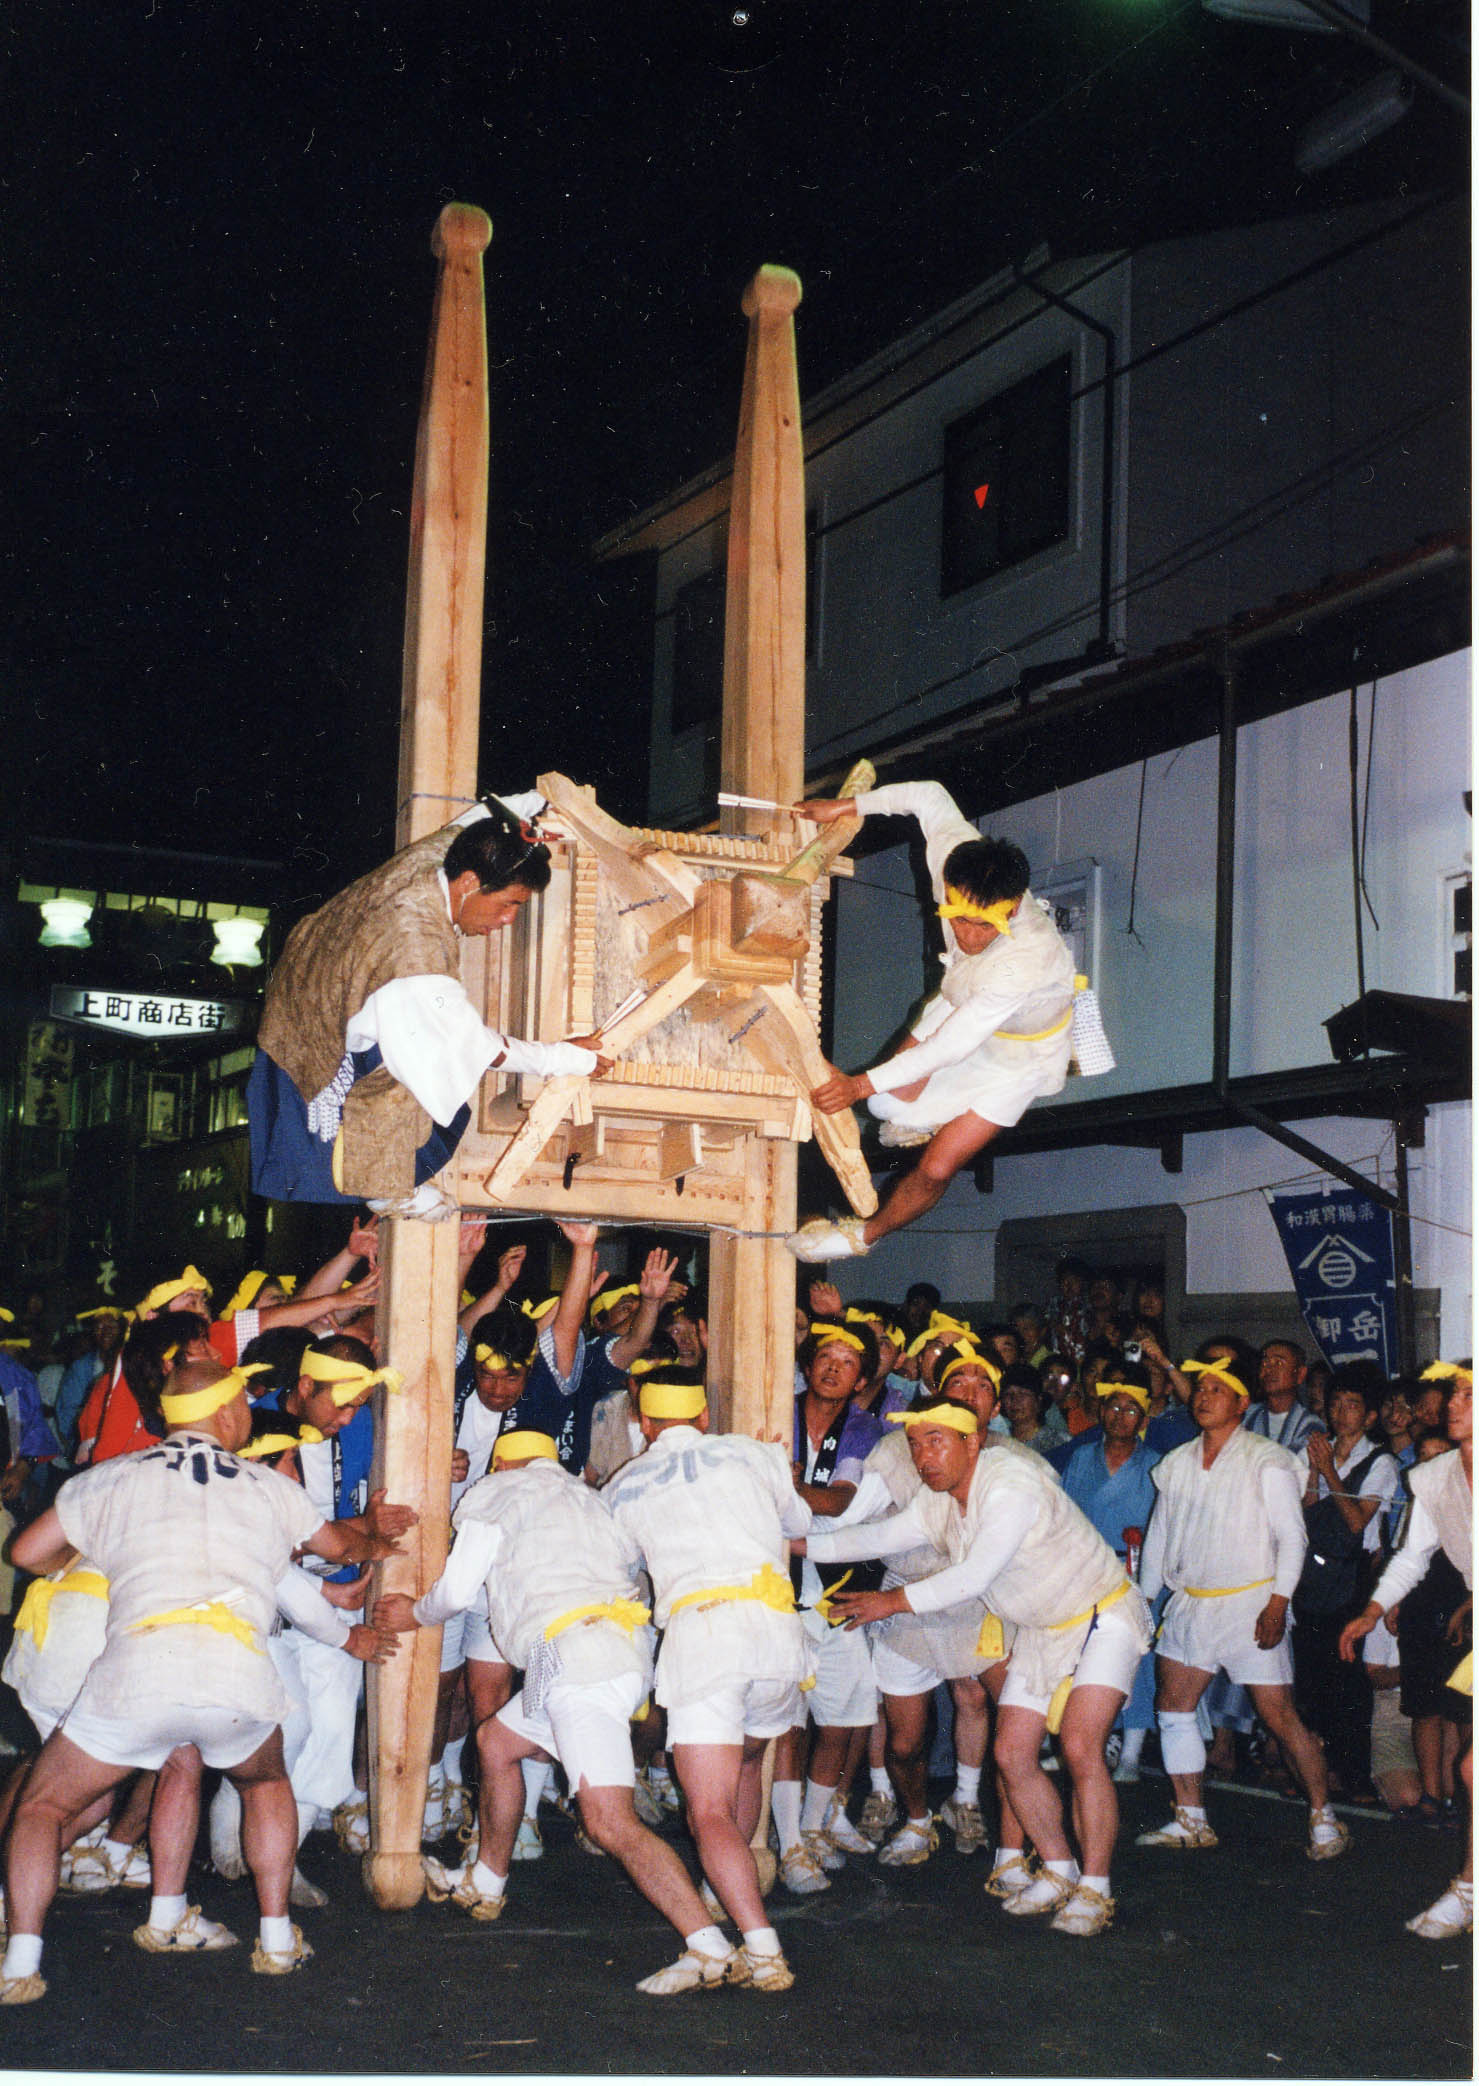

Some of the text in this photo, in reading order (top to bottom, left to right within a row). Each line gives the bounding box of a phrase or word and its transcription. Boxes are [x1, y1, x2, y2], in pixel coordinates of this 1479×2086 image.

[74, 992, 226, 1030] 上町商店街
